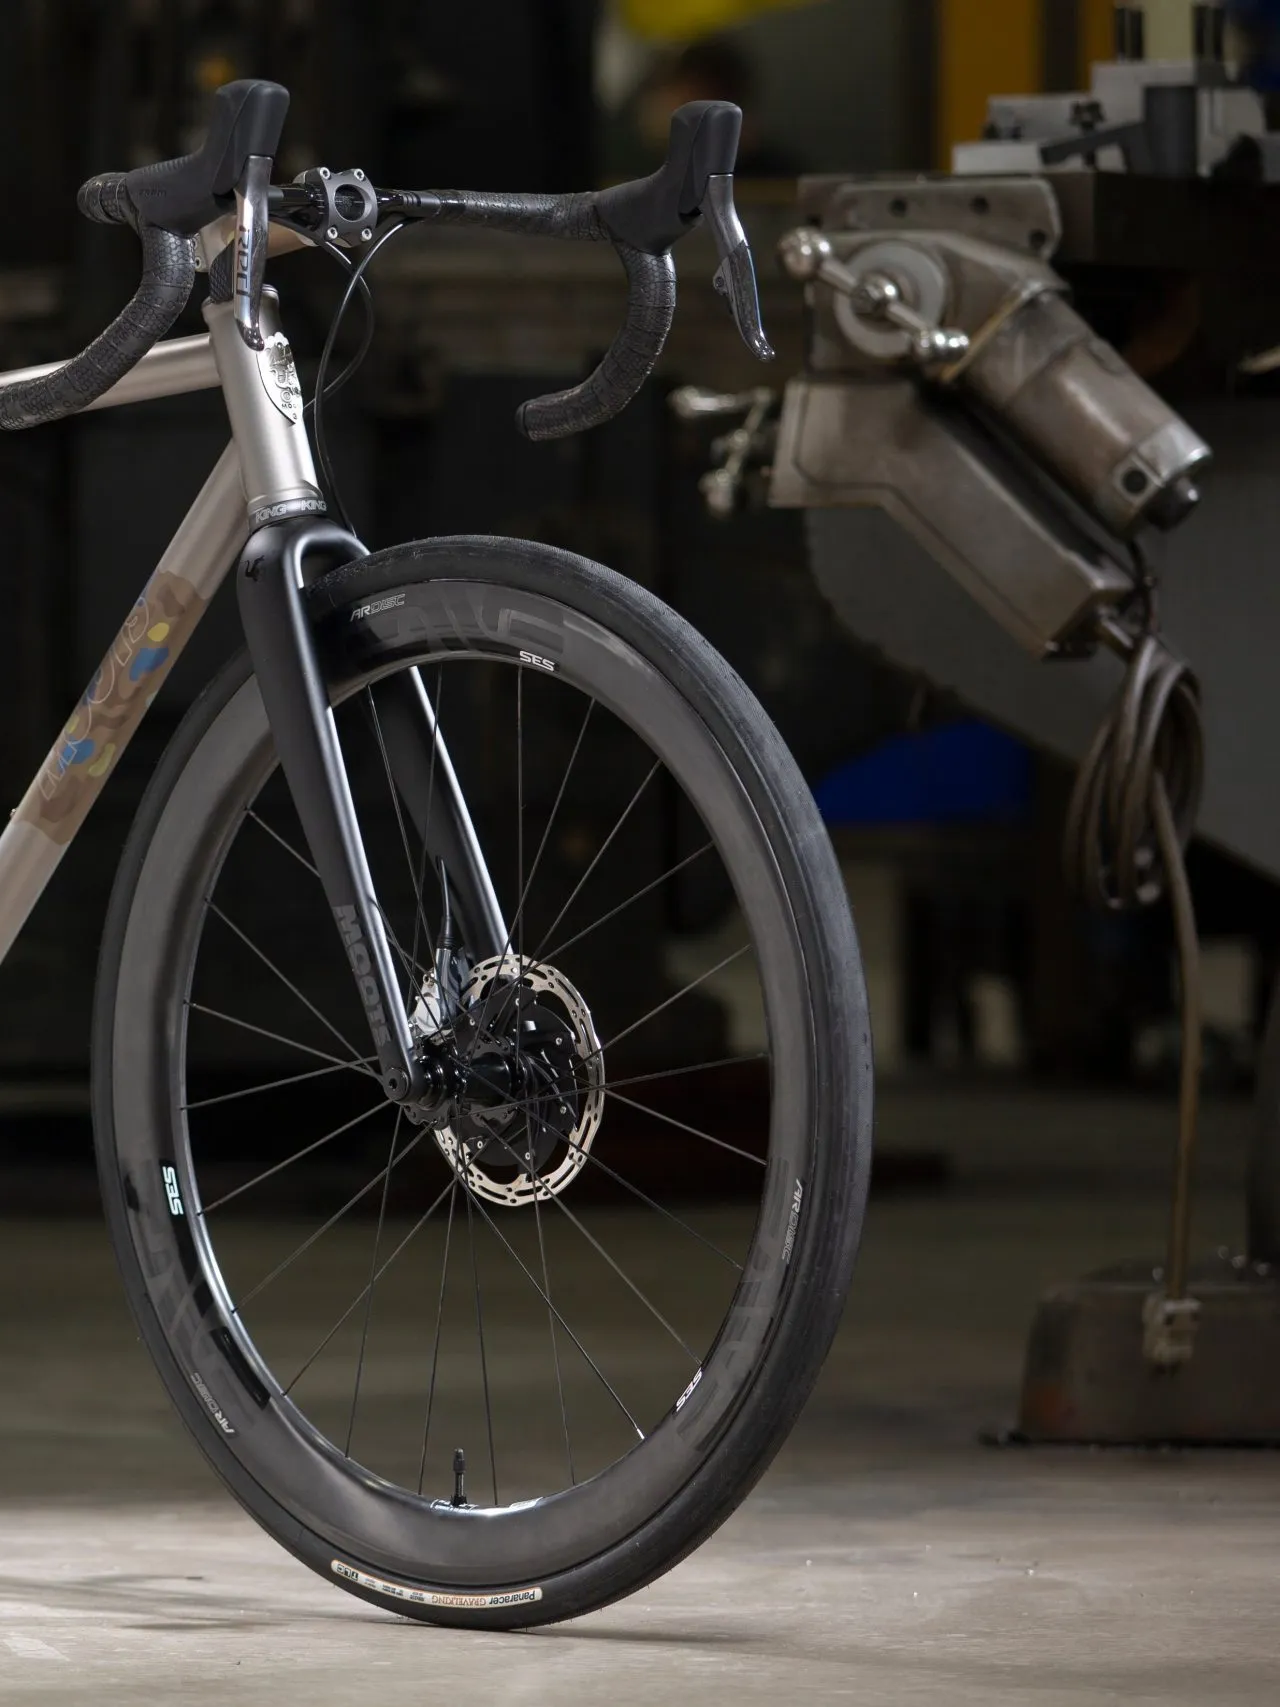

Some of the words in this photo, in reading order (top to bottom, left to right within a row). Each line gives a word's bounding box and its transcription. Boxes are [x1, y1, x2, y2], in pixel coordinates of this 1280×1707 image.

[256, 504, 287, 524] KING
[300, 500, 327, 512] KING
[519, 650, 555, 672] SES
[331, 904, 391, 1048] MOOTS
[162, 1166, 184, 1216] SES
[675, 1366, 703, 1412] SES
[489, 1590, 536, 1605] Panaracer
